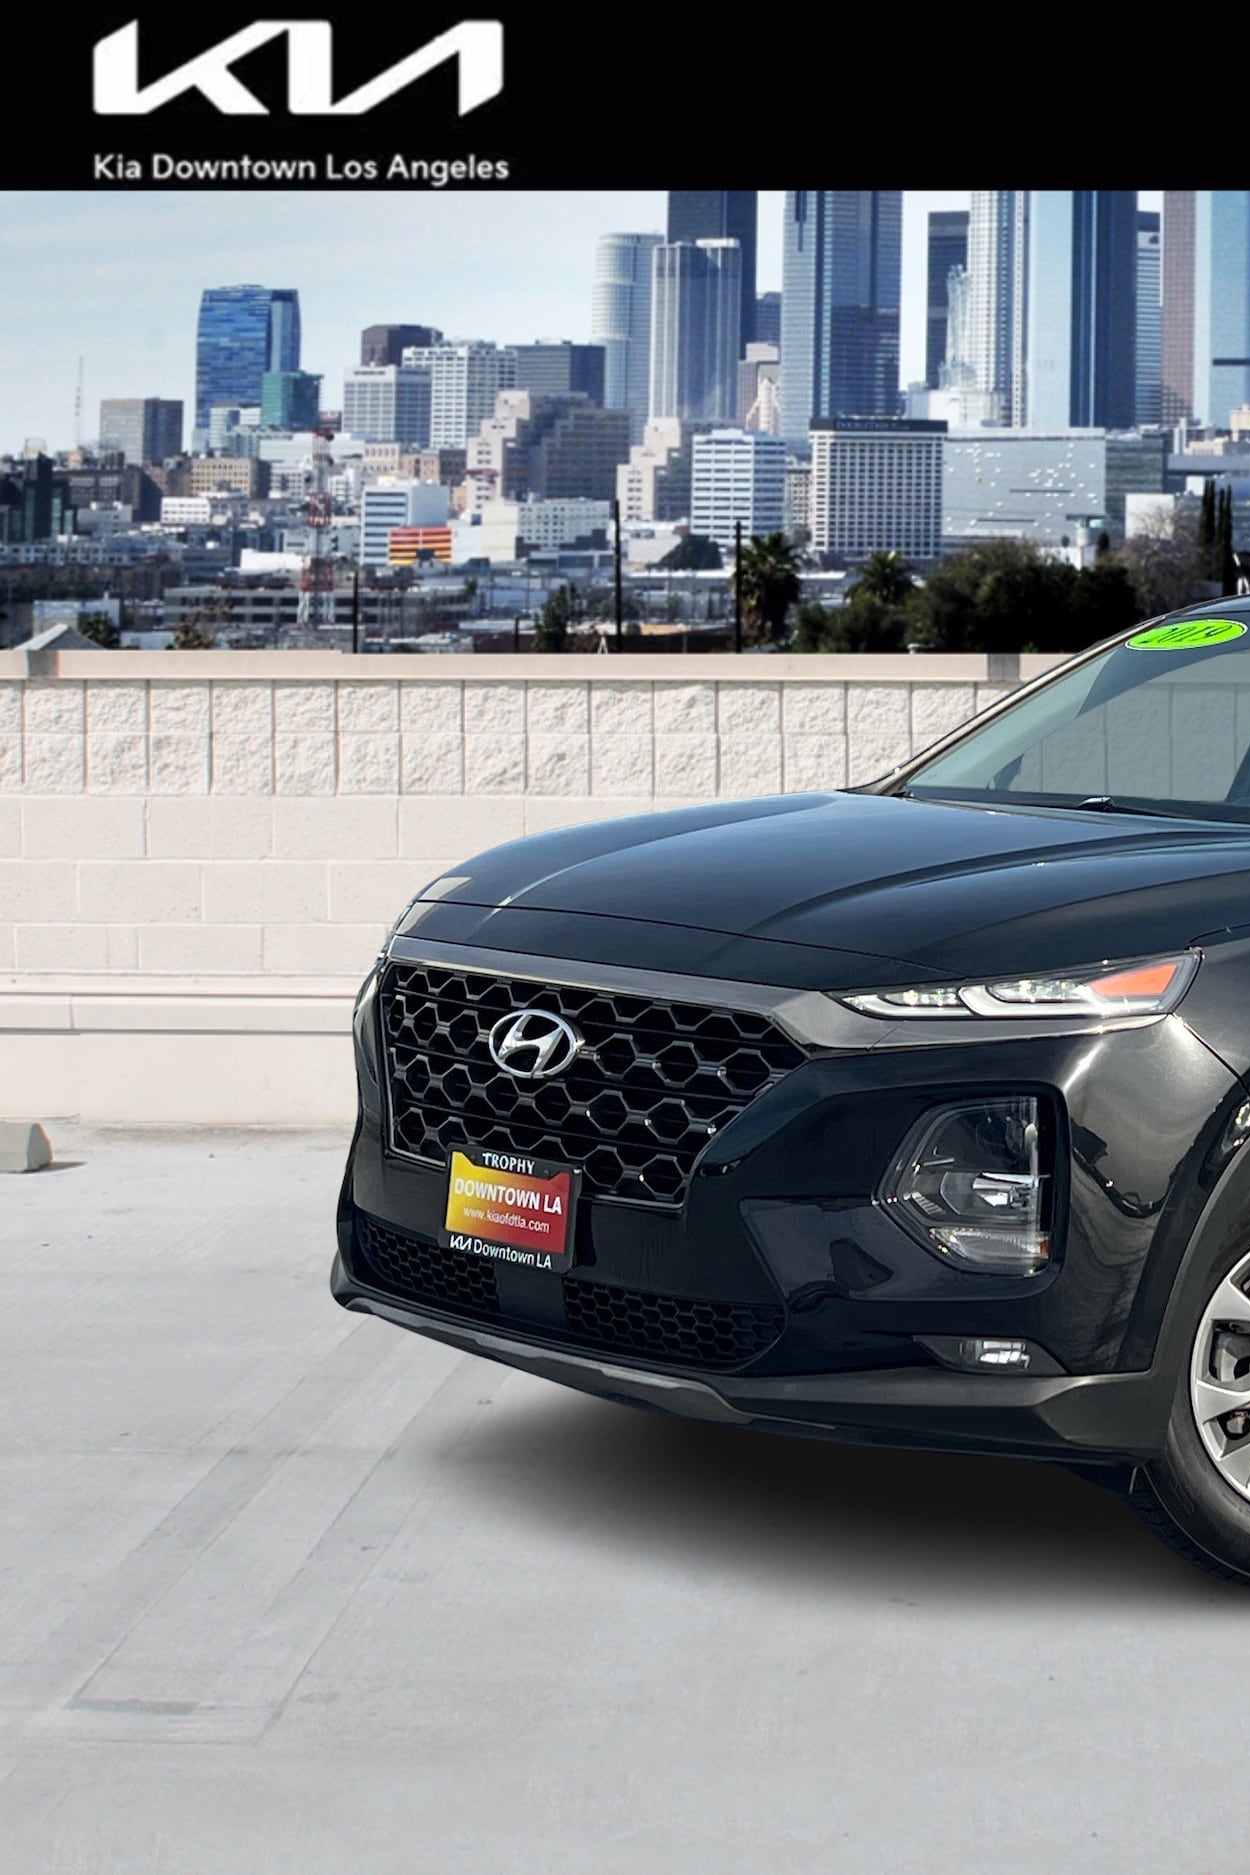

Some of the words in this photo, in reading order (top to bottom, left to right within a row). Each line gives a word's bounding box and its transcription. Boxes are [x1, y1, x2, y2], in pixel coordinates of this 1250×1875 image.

[482, 1152, 535, 1174] TROPHY
[455, 1178, 540, 1211] DOWNTOWN
[543, 1195, 563, 1215] LA
[473, 1239, 535, 1266] Downtown
[536, 1253, 552, 1269] LA
